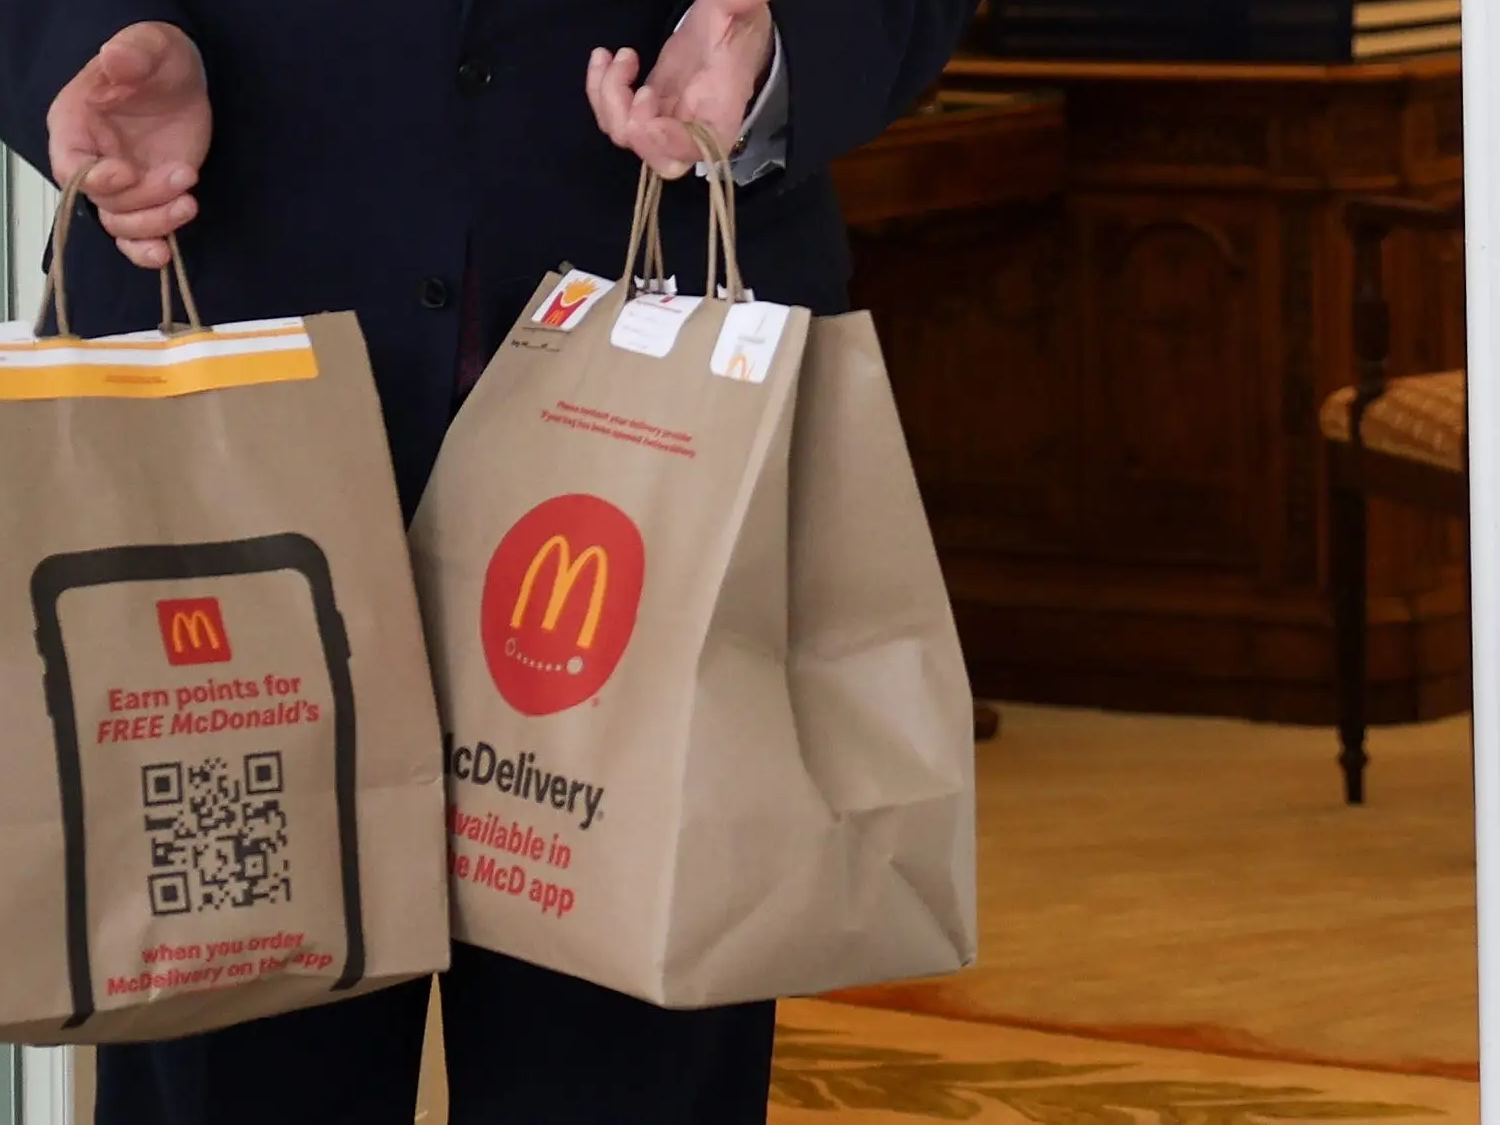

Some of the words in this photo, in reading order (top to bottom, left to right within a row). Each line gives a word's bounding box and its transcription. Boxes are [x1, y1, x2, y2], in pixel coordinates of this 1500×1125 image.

[108, 687, 170, 713] Earn
[176, 678, 259, 711] points
[263, 673, 301, 696] for
[96, 714, 165, 745] FREE
[169, 699, 321, 736] McDonald's
[547, 833, 572, 869] in
[473, 855, 526, 896] McD
[528, 878, 576, 920] app
[142, 943, 201, 964] when
[206, 940, 243, 963] you
[247, 931, 306, 952] order
[107, 964, 224, 996] McDelivery
[227, 961, 253, 977] on
